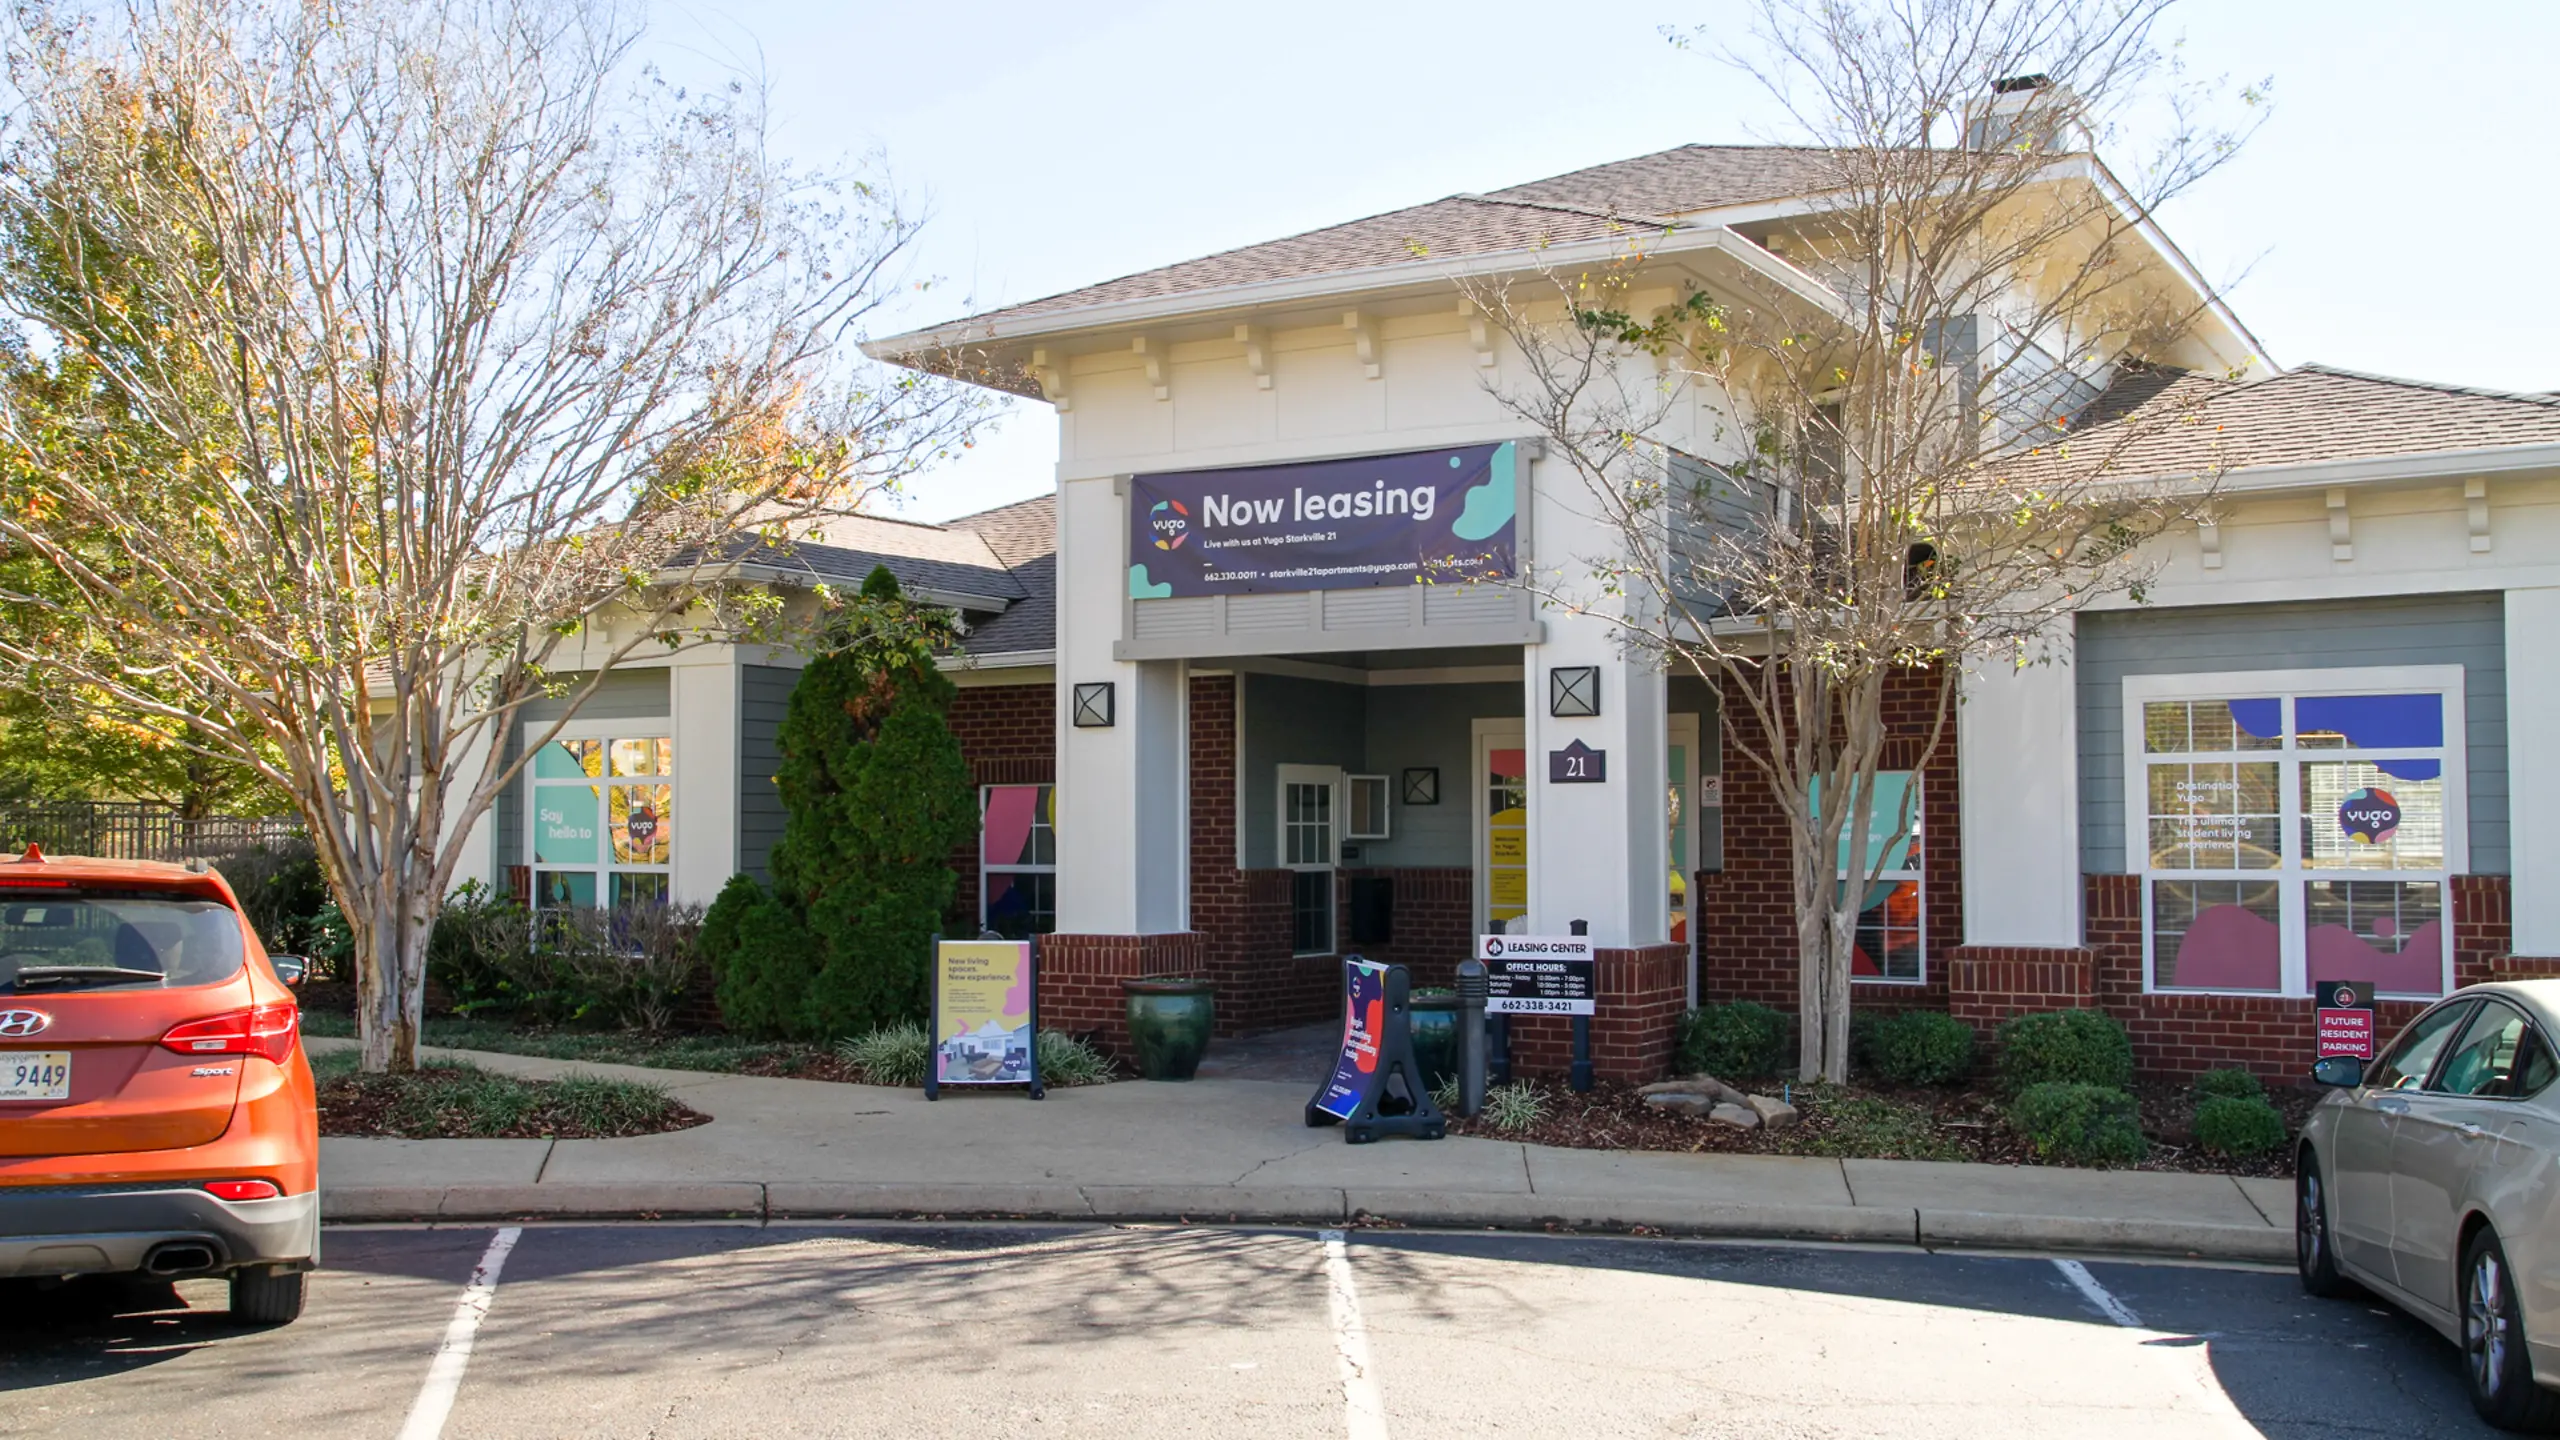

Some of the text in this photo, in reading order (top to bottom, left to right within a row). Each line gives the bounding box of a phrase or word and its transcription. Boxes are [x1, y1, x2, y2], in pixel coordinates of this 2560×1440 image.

[1203, 480, 1436, 528] Now leasing
[1153, 520, 1185, 536] yugo
[1203, 540, 1221, 548] Live
[1223, 538, 1240, 547] with
[1263, 536, 1284, 546] Yugo
[1285, 532, 1326, 543] Starkville
[1327, 532, 1337, 540] 21
[1204, 571, 1257, 581] 662.330.0011
[1269, 562, 1418, 578] starkville21apartments@yugo.com
[1566, 756, 1586, 777] 21
[540, 808, 563, 824] Say
[2347, 810, 2392, 829] yugo
[549, 826, 592, 839] hello to
[631, 821, 653, 835] yugo
[1508, 943, 1586, 953] LEASING CENTER
[948, 957, 989, 966] New living
[1506, 963, 1567, 972] OFFICE HOURS:
[967, 973, 1013, 981] experience.
[1502, 1001, 1571, 1011] 662-338-3421
[2324, 1016, 2364, 1026] FUTURE
[2320, 1029, 2369, 1039] RESIDENT
[2322, 1042, 2367, 1052] PARKING
[15, 1065, 66, 1087] 9449
[192, 1067, 233, 1077] Sport
